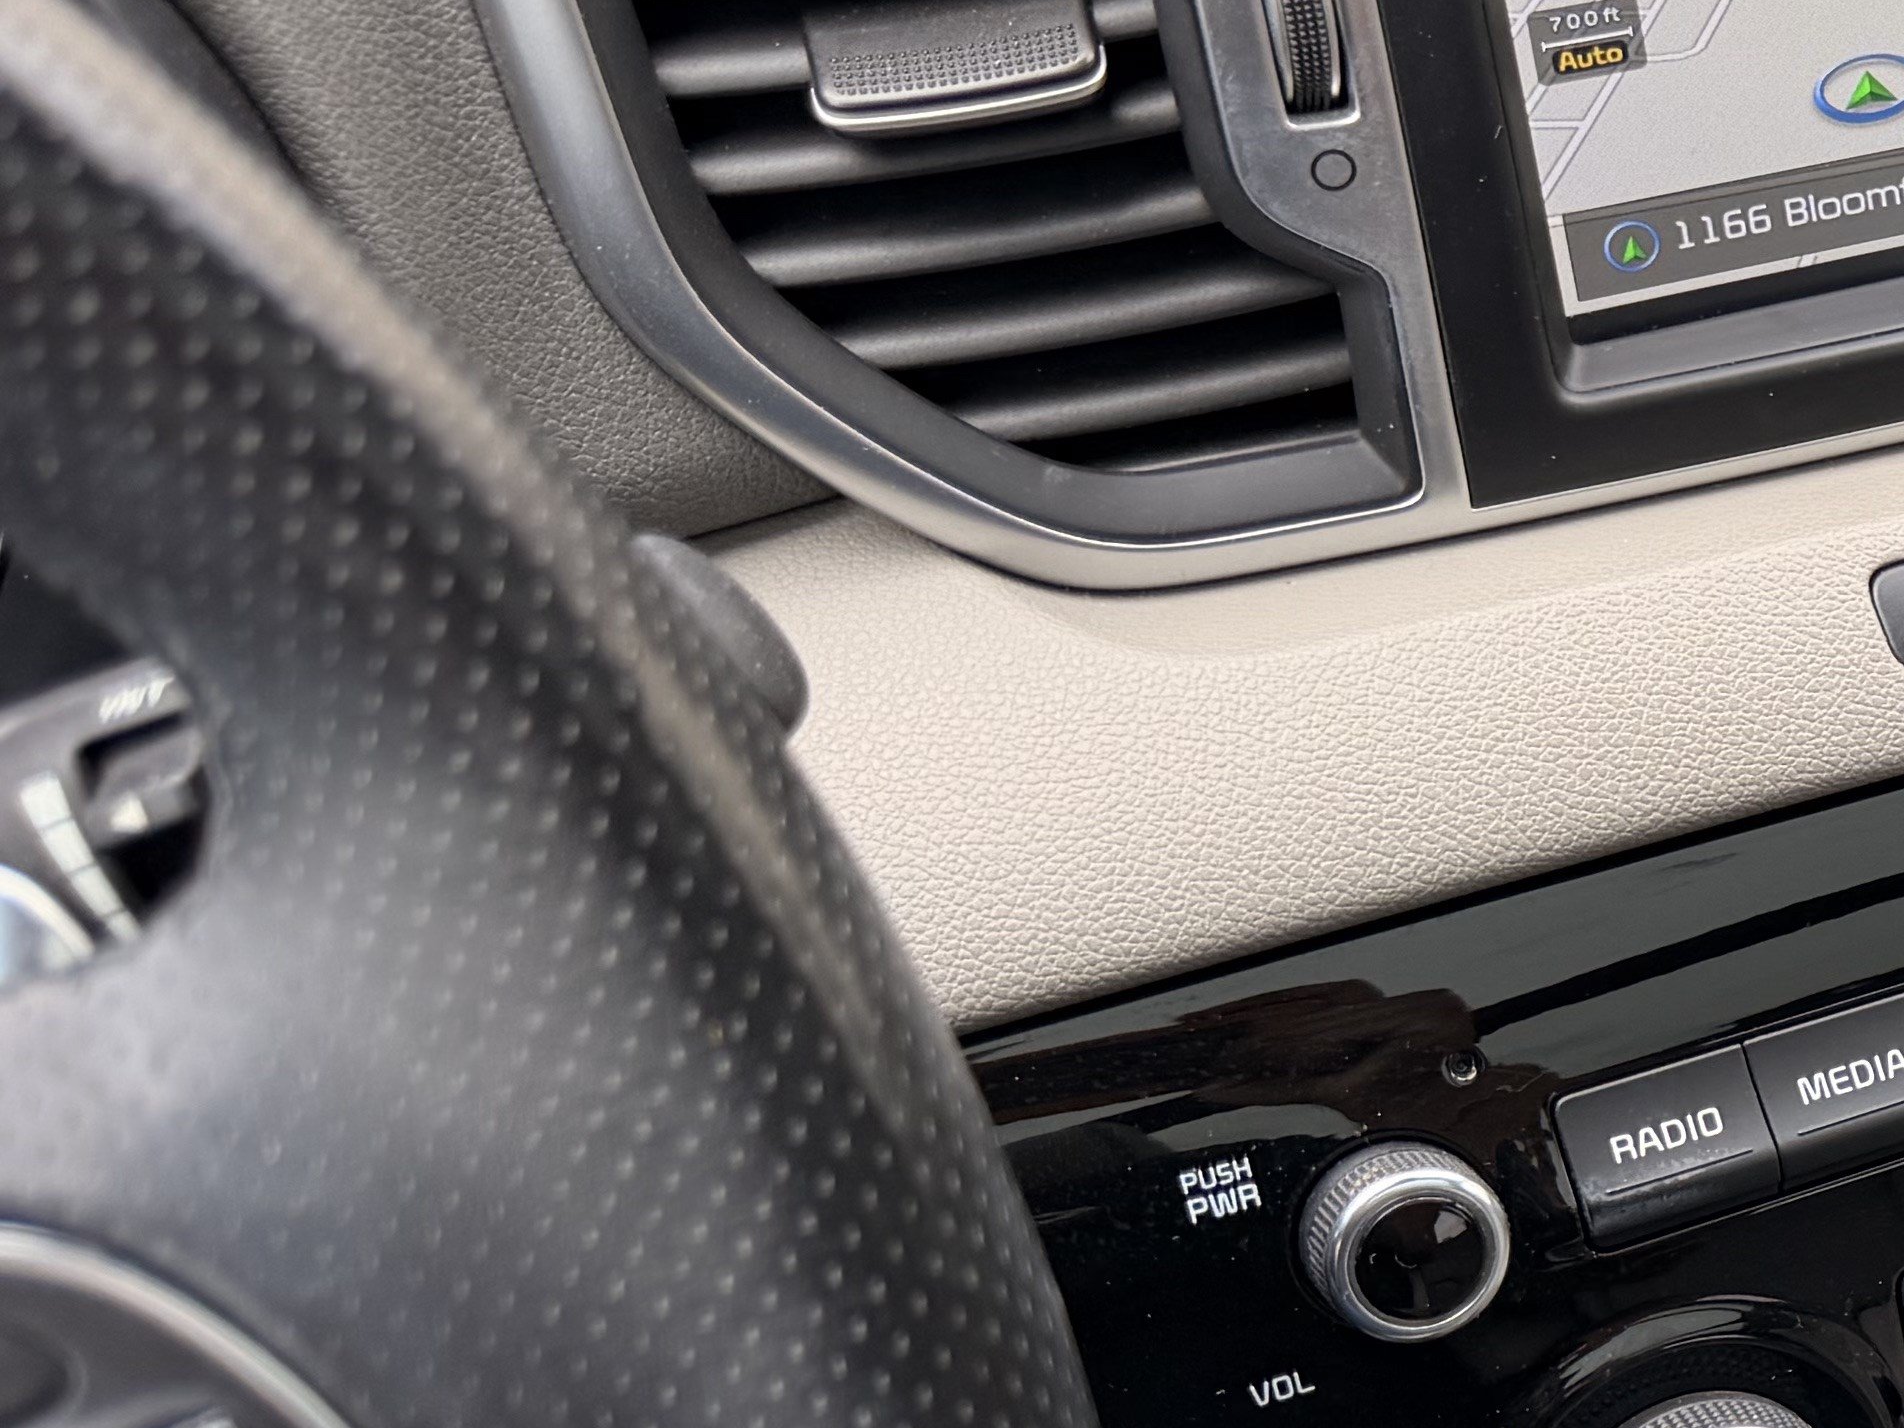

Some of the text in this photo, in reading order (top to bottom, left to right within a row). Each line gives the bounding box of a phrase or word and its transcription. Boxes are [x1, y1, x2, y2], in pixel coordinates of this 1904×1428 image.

[1557, 44, 1625, 72] Auto
[1675, 203, 1773, 251] 1166
[1609, 1106, 1724, 1164] RADIO
[1178, 1155, 1254, 1197] PUSH
[1186, 1179, 1262, 1225] PWR
[1248, 1369, 1316, 1408] VOL
